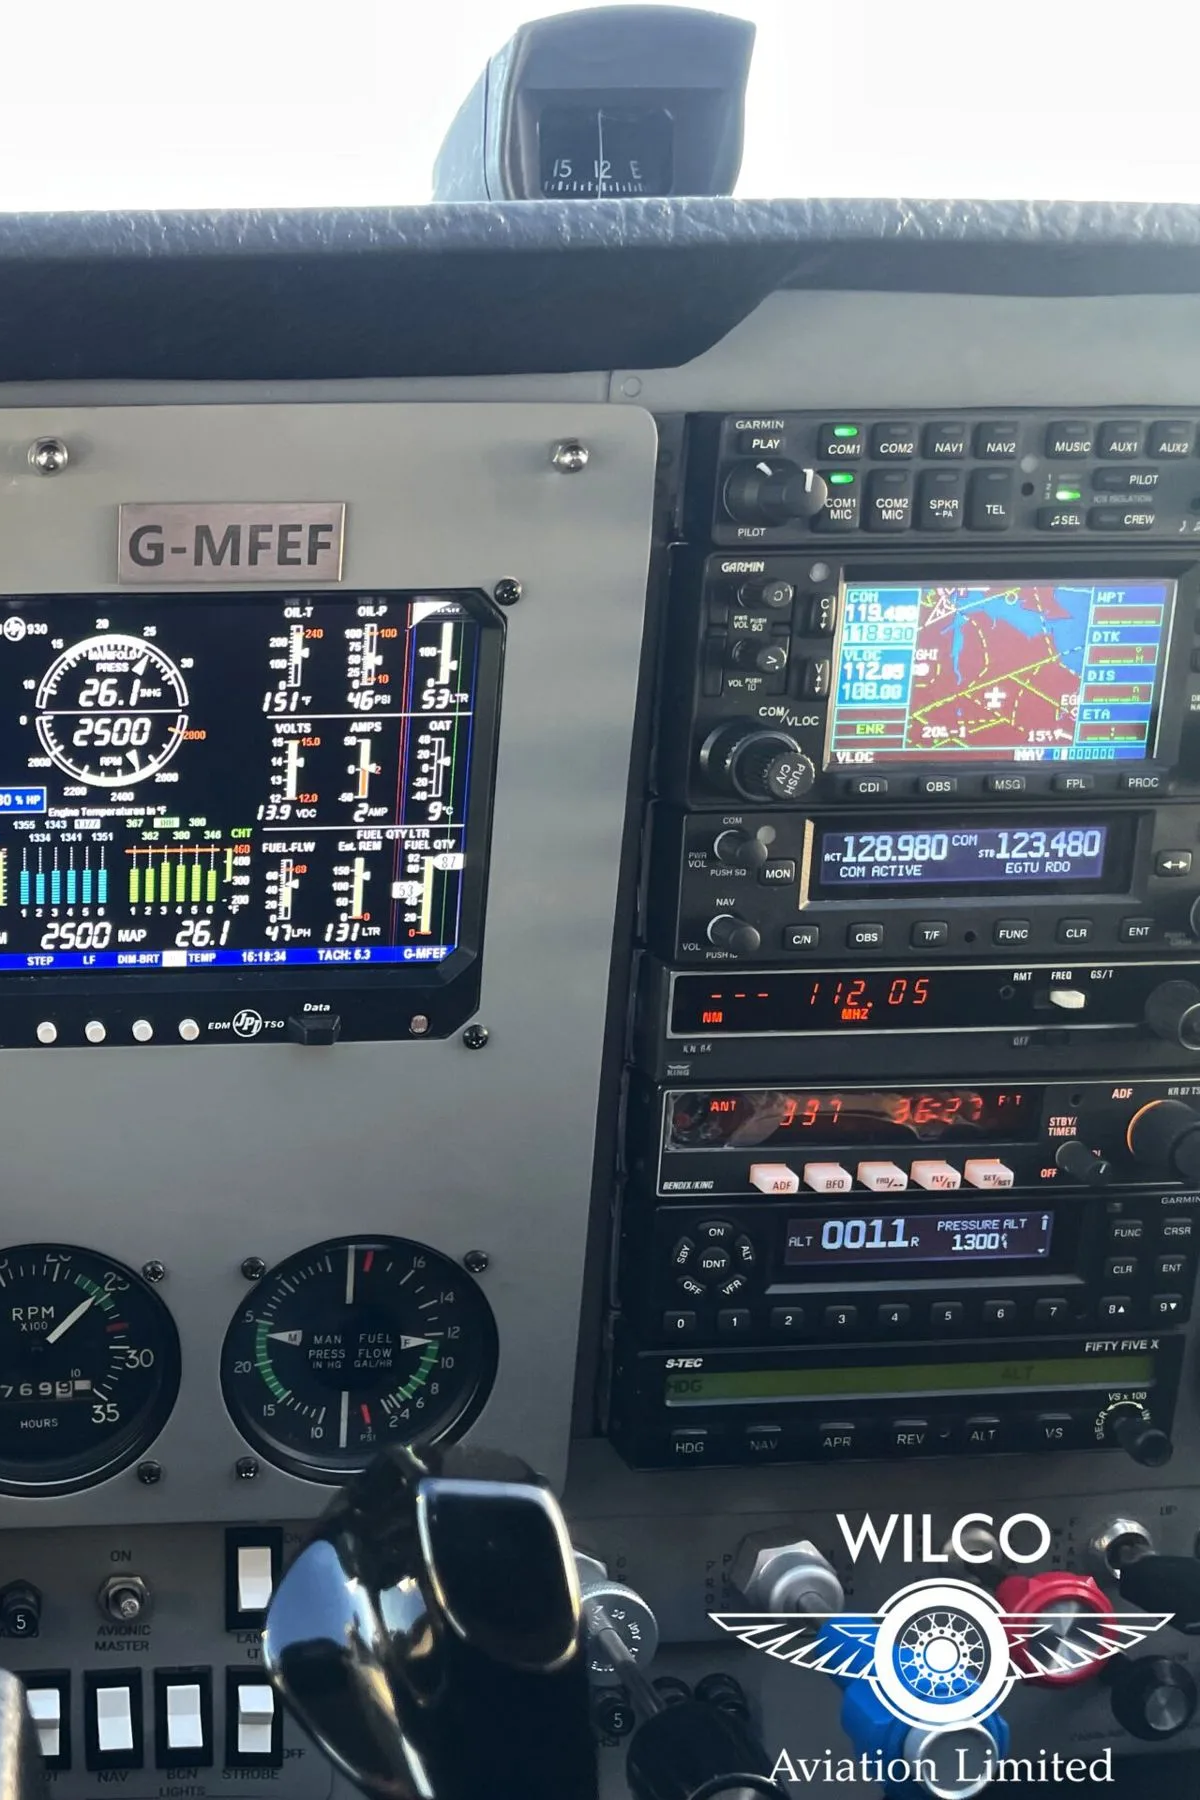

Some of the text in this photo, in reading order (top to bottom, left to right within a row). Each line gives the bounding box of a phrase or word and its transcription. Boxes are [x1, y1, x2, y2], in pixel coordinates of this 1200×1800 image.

[553, 159, 572, 178] 15
[594, 160, 612, 178] 12
[630, 161, 642, 179] E
[736, 420, 784, 430] GARMIN
[752, 439, 780, 450] PLAY
[828, 443, 860, 455] COM1
[879, 443, 914, 454] COM2
[935, 442, 963, 453] NAV1
[986, 442, 1016, 453] NAV2
[1055, 441, 1091, 452] MUSIC
[1110, 441, 1138, 452] AUX1
[1159, 442, 1188, 453] AUX2
[1129, 474, 1158, 485] PILOT
[825, 498, 856, 508] COM1
[876, 498, 908, 508] COM2
[929, 500, 959, 510] SPKR
[830, 509, 852, 520] MIC
[882, 509, 903, 520] MIC
[986, 504, 1005, 515] TEL
[1124, 514, 1155, 525] CREW
[738, 528, 765, 538] PILOT
[129, 524, 333, 567] G-MFEF
[721, 563, 764, 572] GARMIN
[284, 607, 313, 618] OIL-T
[358, 606, 387, 616] OIL-P
[27, 624, 48, 635] 930
[305, 629, 323, 638] 240
[1093, 631, 1120, 643] DTK
[96, 663, 128, 672] PRESS
[1087, 669, 1115, 681] DIS
[79, 678, 141, 707] 26.1
[1083, 708, 1110, 720] ETA
[276, 724, 311, 733] VOLTS
[350, 722, 381, 732] AMPS
[429, 721, 452, 731] OAT
[856, 723, 884, 735] ENR
[73, 718, 151, 746] 2500
[859, 782, 879, 793] CDI
[926, 781, 951, 792] OBS
[1066, 779, 1085, 789] FPL
[1128, 777, 1159, 788] PROC
[231, 829, 252, 837] CHT
[952, 833, 978, 847] COM
[997, 830, 1099, 859] 123.480
[824, 833, 948, 864] ACT 128.980
[840, 864, 921, 878] COM ACTIVE
[1005, 861, 1071, 875] EGTU RDO
[765, 868, 791, 880] MON
[41, 922, 112, 949] 2500
[118, 930, 146, 942] MAP
[175, 920, 230, 947] 26.1
[999, 928, 1028, 940] FUNC
[1066, 927, 1087, 939] CLR
[1129, 926, 1149, 937] ENT
[855, 931, 878, 944] OBS
[188, 953, 216, 963] TEMP
[404, 949, 447, 959] G-MFEF
[27, 956, 54, 965] STEP
[83, 956, 96, 965] LF
[1051, 970, 1072, 981] FREQ
[1091, 969, 1114, 980] GS/T
[810, 979, 930, 1008] 112.05
[304, 1003, 330, 1012] Data
[841, 1008, 869, 1020] MHZ
[1112, 1088, 1133, 1099] ADF
[1049, 1117, 1077, 1129] STBY/
[1048, 1126, 1077, 1137] TIMER
[1041, 1168, 1057, 1179] OFF
[663, 1180, 714, 1190] BENDIX/KING
[937, 1218, 1028, 1232] PRESSURE ALT
[821, 1218, 908, 1250] 0011
[677, 1244, 689, 1264] SBY
[702, 1258, 727, 1269] IDNT
[12, 1306, 54, 1321] RPM
[21, 1322, 48, 1332] X100
[314, 1335, 342, 1344] MAN
[359, 1334, 392, 1344] FUEL
[1085, 1339, 1159, 1352] FIFTY FIVE X
[125, 1349, 154, 1368] 30
[308, 1350, 345, 1359] PRESS
[358, 1349, 392, 1358] FLOW
[234, 1362, 251, 1372] 20
[354, 1359, 392, 1368] GAL/HR
[666, 1358, 703, 1368] S-TEC
[92, 1404, 120, 1423] 35
[263, 1405, 275, 1416] 15
[20, 1418, 58, 1428] HOURS
[824, 1435, 852, 1448] APR
[897, 1433, 924, 1446] REV
[111, 1551, 131, 1562] ON
[97, 1625, 150, 1636] AVIONIC
[95, 1641, 149, 1651] MASTER
[97, 1771, 128, 1782] NAV
[167, 1769, 198, 1779] BCN
[222, 1769, 279, 1780] STROBE
[159, 1787, 205, 1797] LIGHTS
